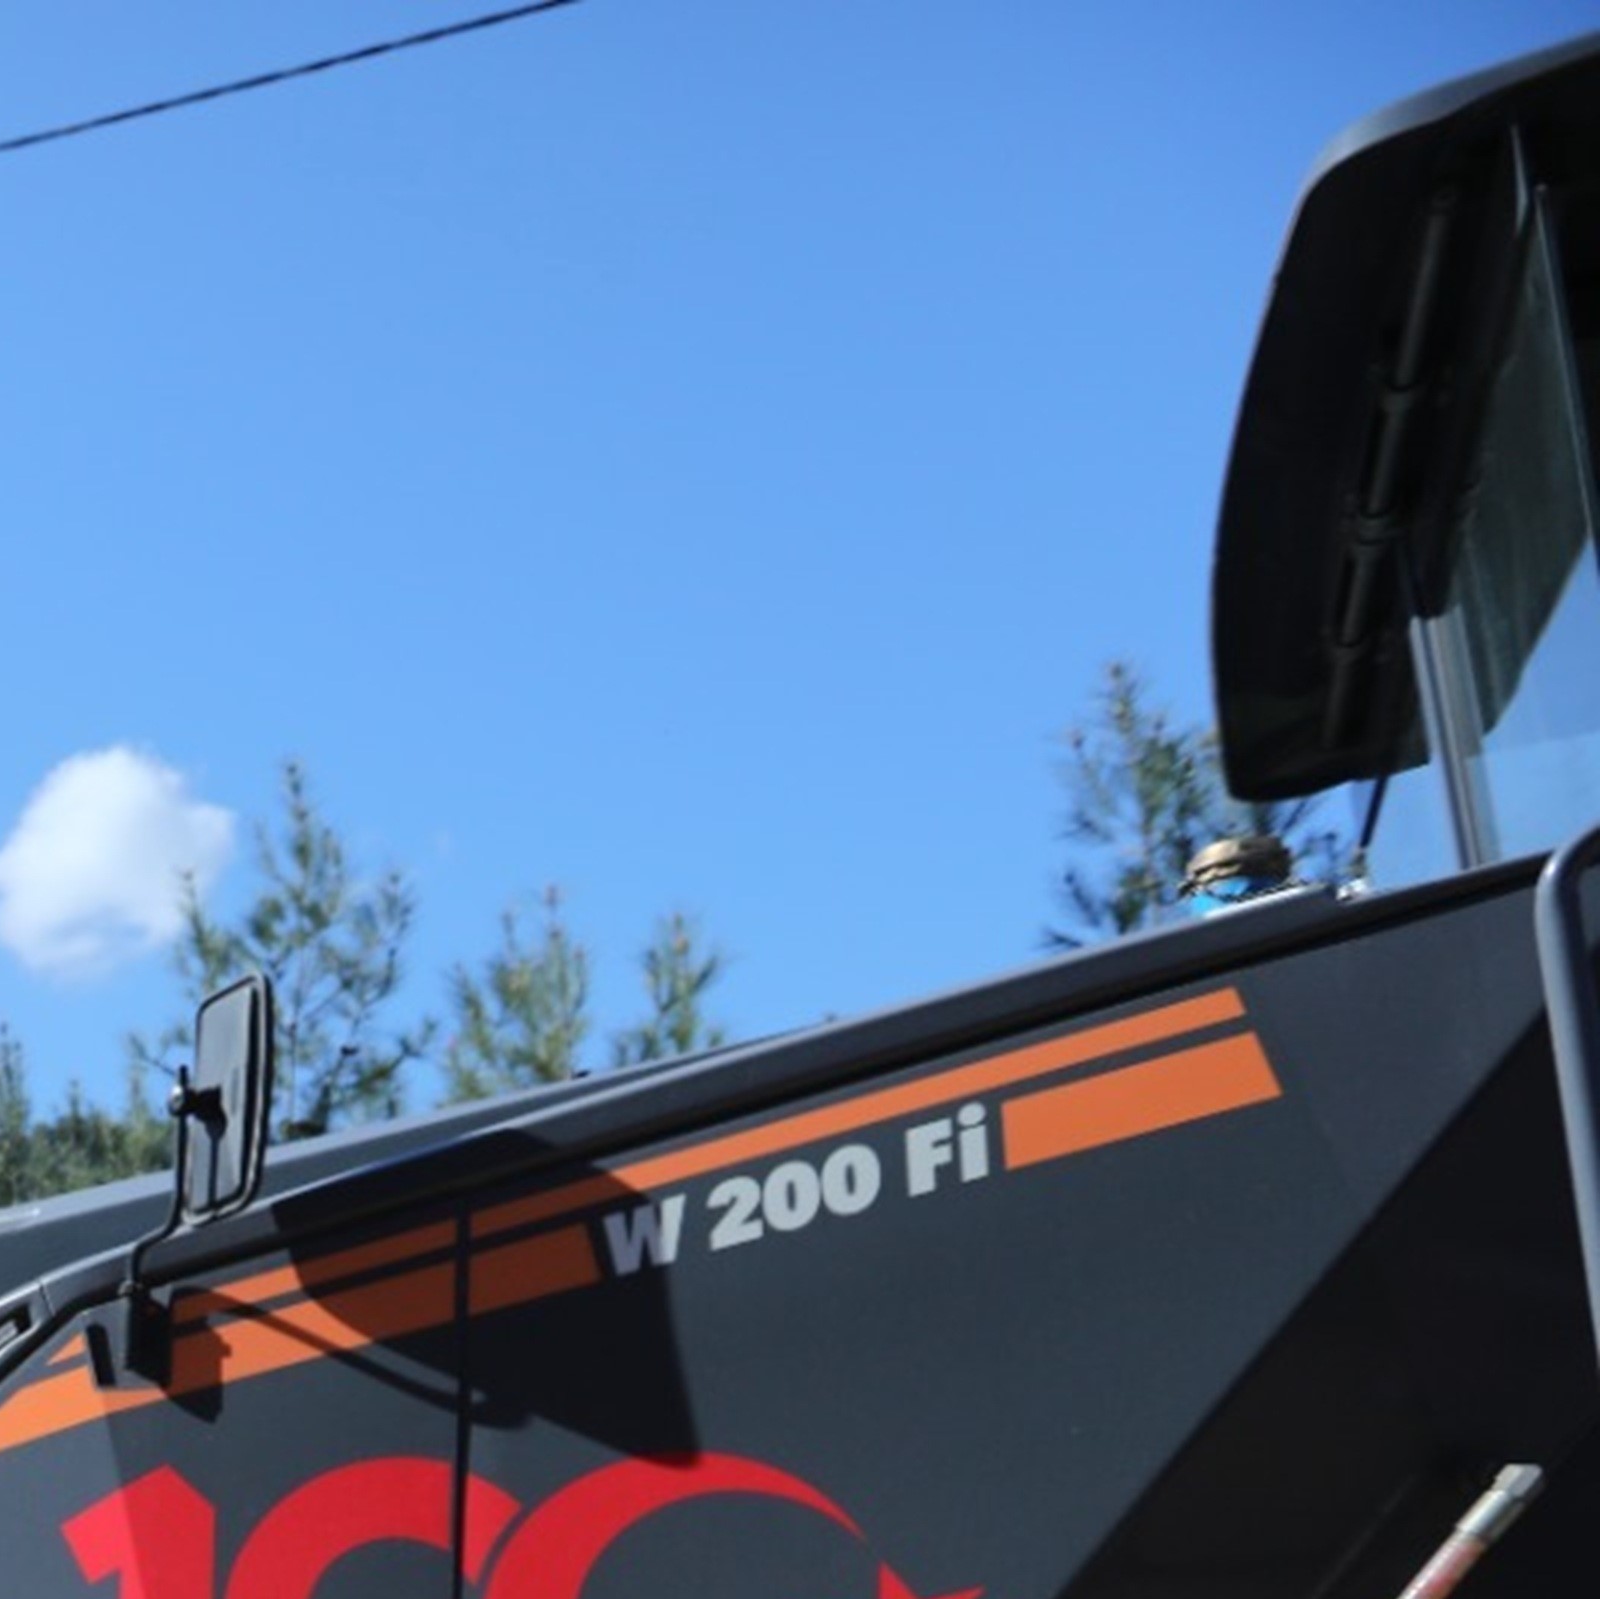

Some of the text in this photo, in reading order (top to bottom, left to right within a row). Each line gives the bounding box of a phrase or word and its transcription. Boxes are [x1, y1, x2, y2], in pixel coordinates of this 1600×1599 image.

[603, 1101, 990, 1277] W 200 Fi
